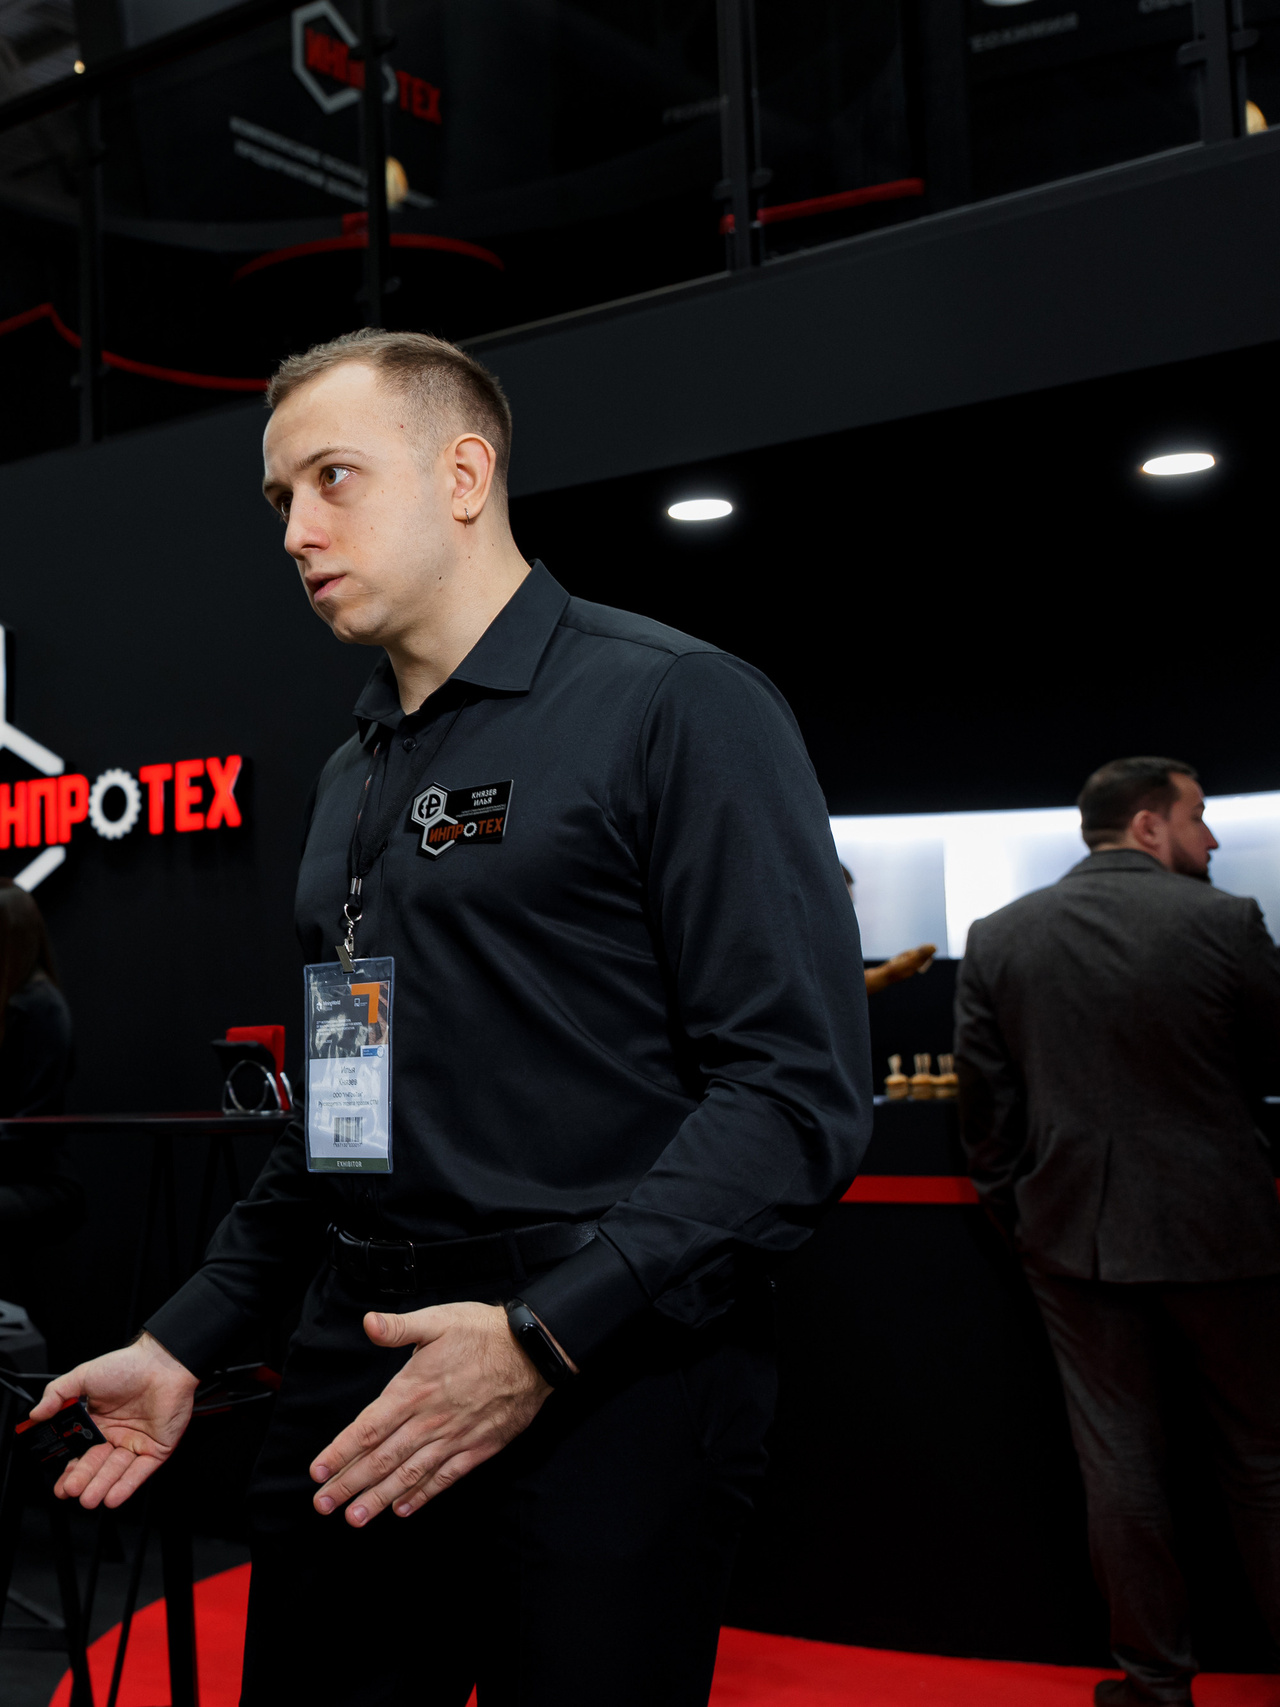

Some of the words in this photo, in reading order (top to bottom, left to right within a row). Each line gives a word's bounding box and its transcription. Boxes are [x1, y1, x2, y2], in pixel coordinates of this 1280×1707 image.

[471, 788, 497, 799] КНЯЗЕВ
[473, 797, 493, 806] ИЛЬЯ
[428, 817, 504, 843] ИНПРОТЕХ
[336, 1160, 363, 1168] EXHIBITOR
